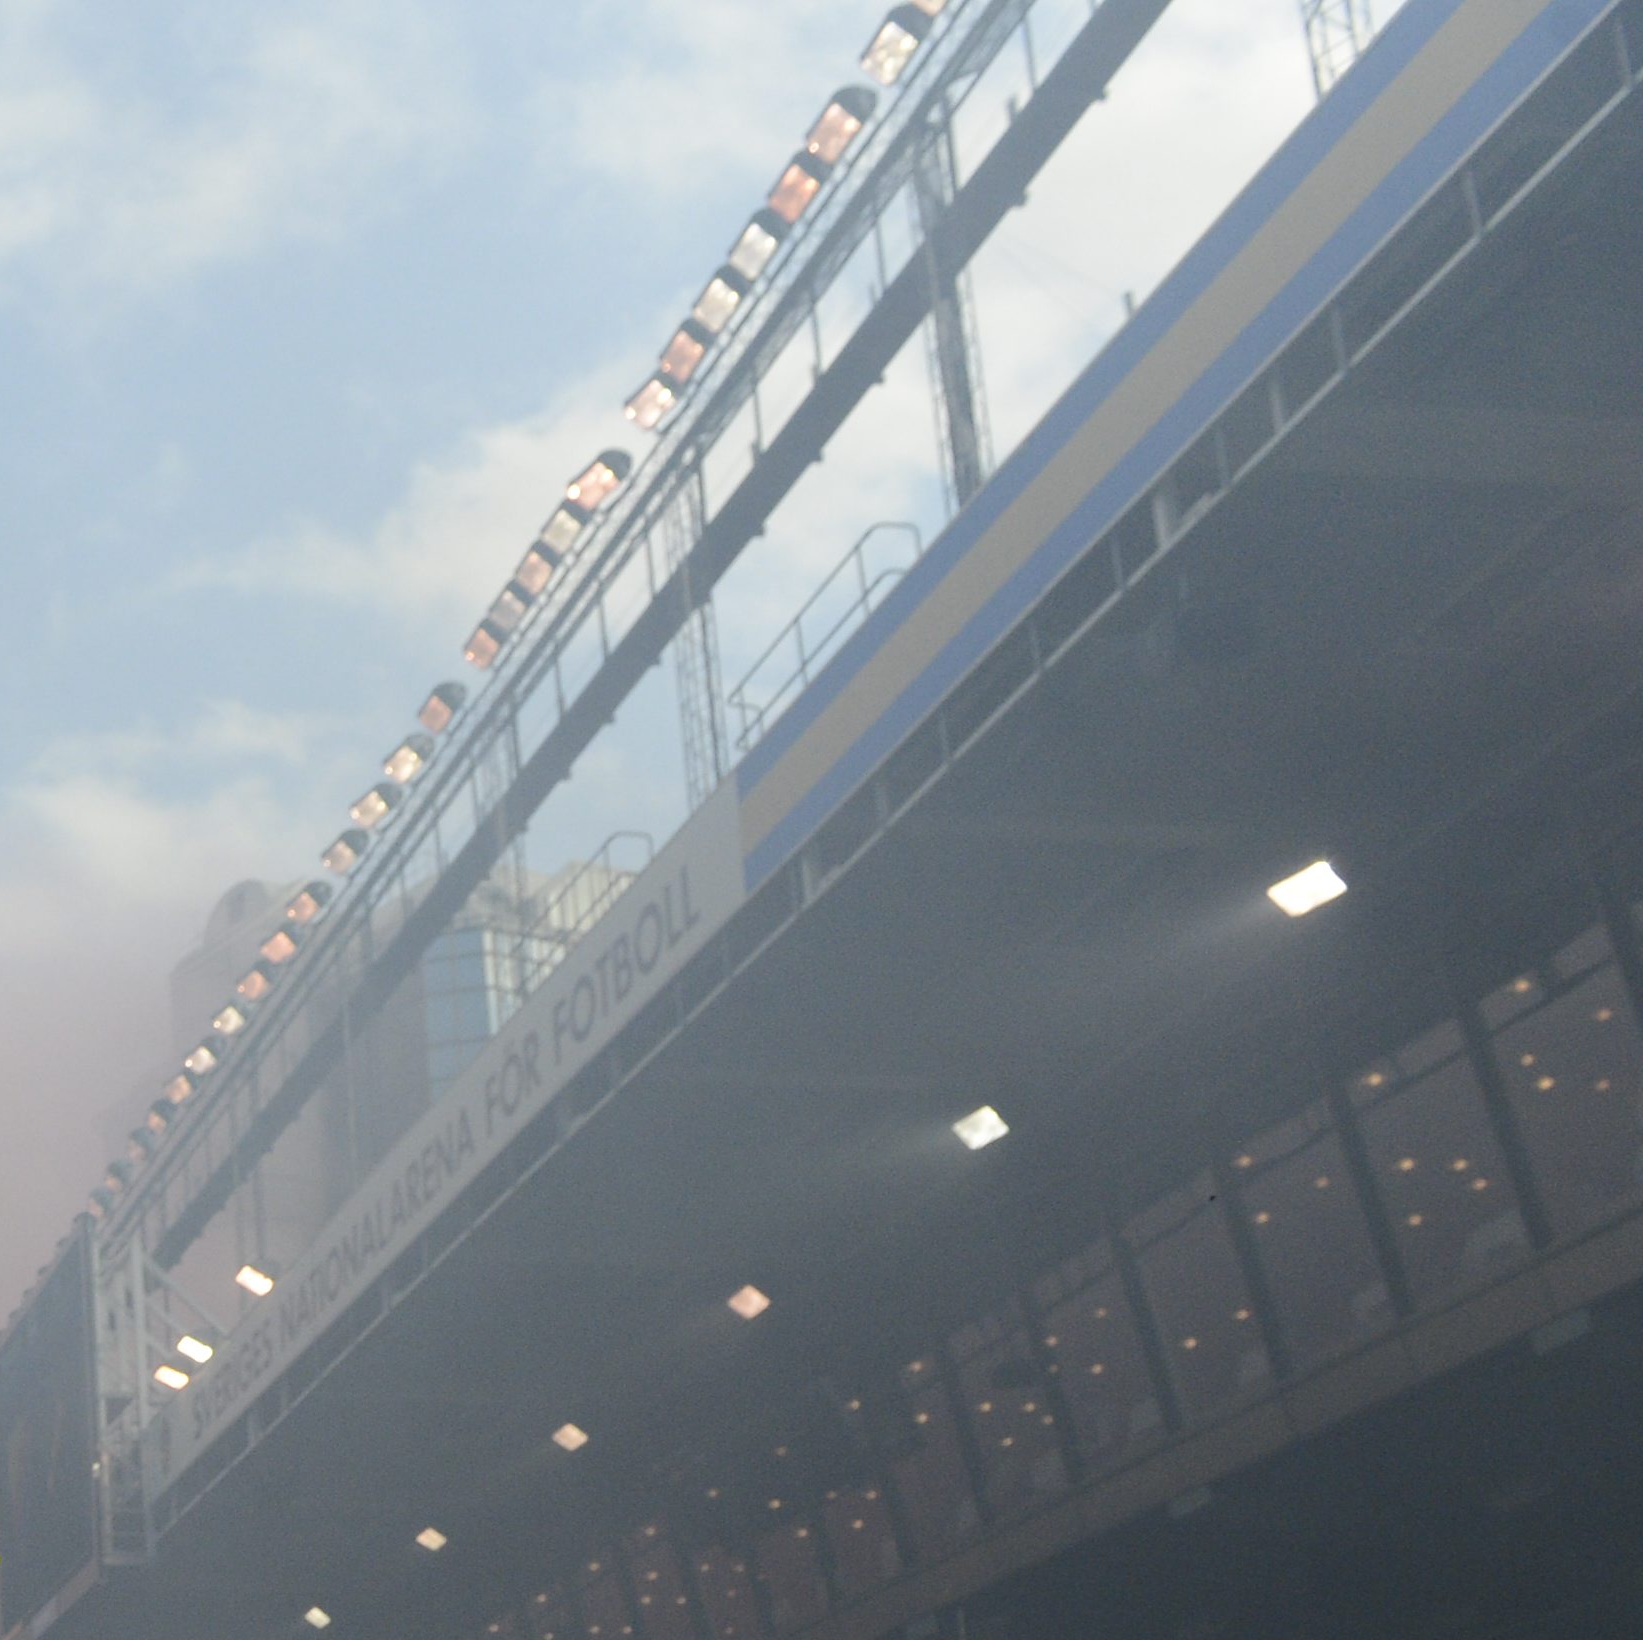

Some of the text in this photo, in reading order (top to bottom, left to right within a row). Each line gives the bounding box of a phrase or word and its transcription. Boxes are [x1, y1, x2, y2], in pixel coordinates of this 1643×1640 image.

[193, 865, 701, 1440] SVERIGES NATIONALARENA FÖR FOTBOLL
